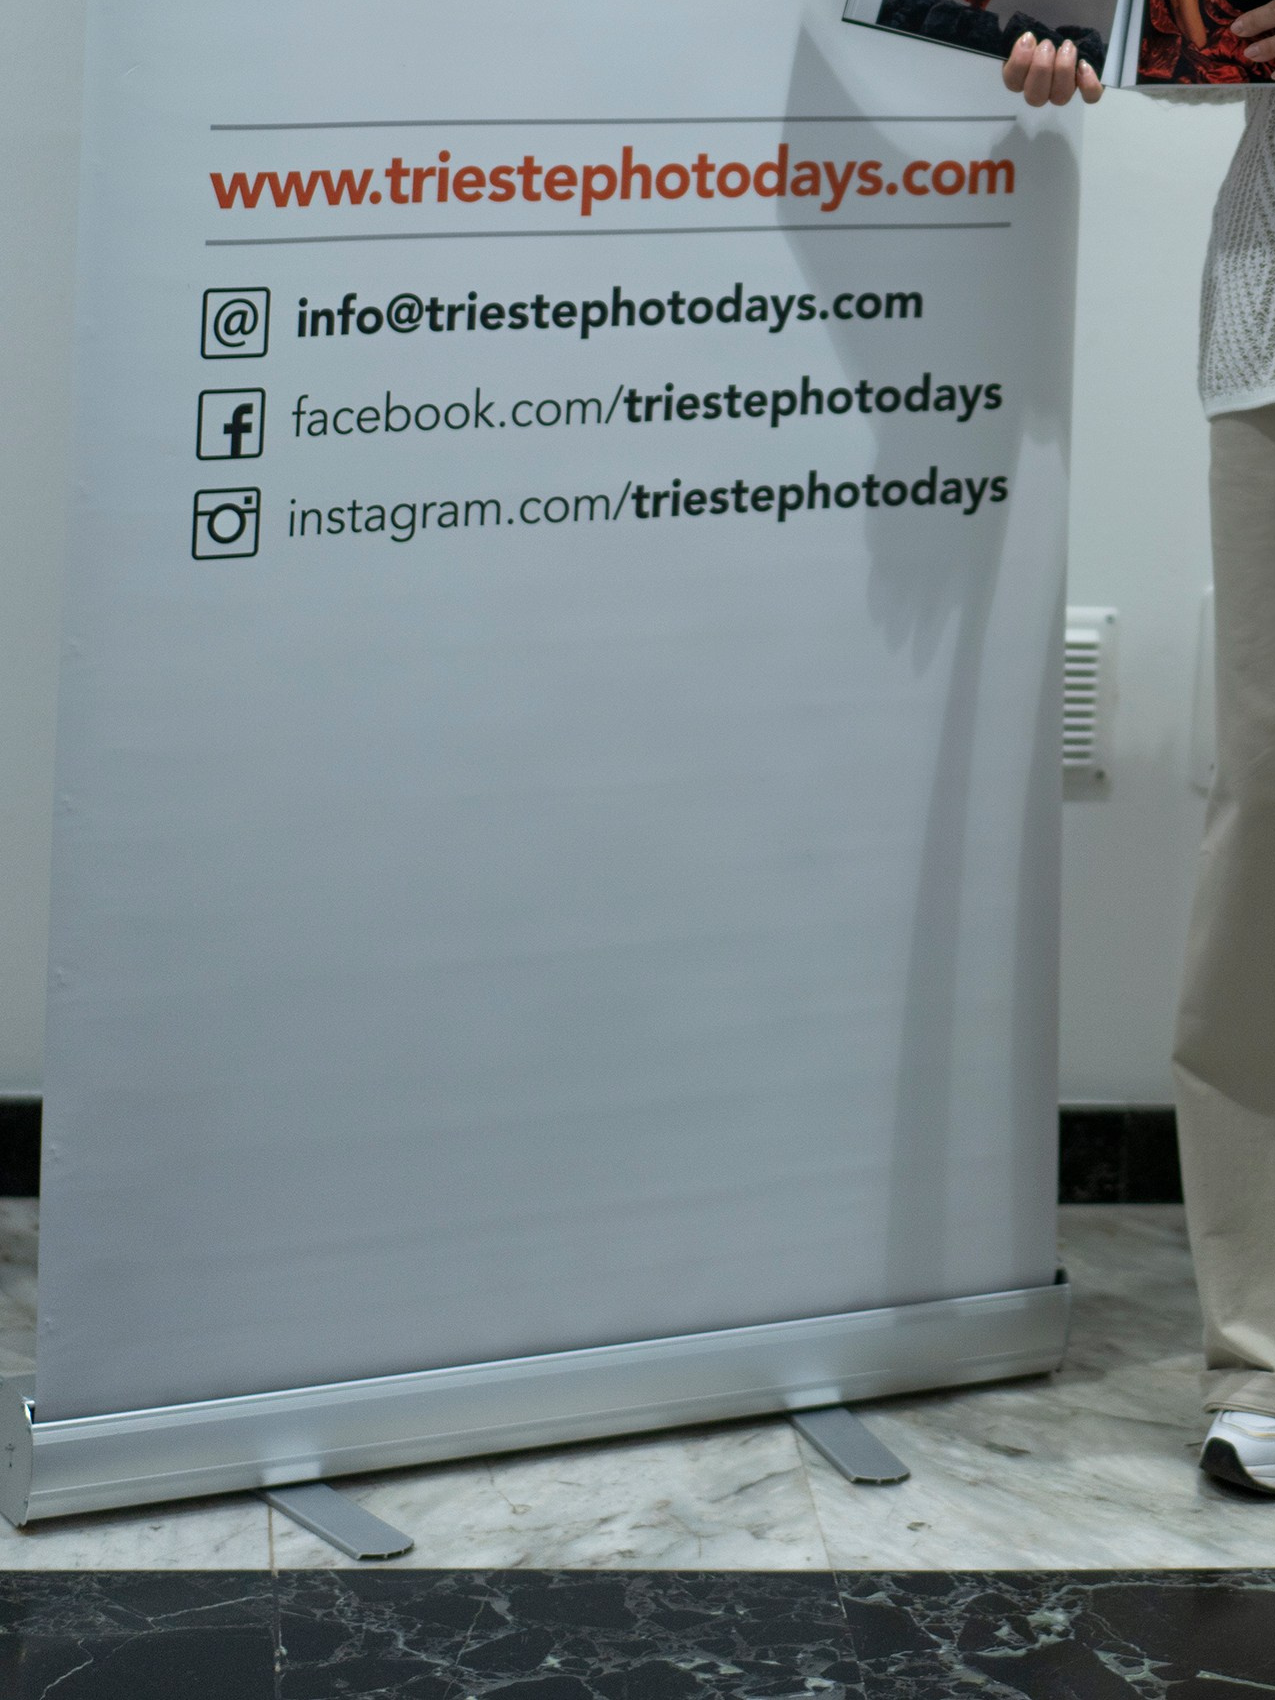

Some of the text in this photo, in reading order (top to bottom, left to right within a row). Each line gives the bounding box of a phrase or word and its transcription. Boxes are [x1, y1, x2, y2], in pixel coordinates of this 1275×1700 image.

[210, 144, 1015, 217] www.triestephotodays.com
[296, 281, 924, 341] info@triestephotodays.com
[291, 371, 1004, 438] facebook.com/triestephotodays
[288, 465, 1009, 543] instagram.com/triestephotodays
